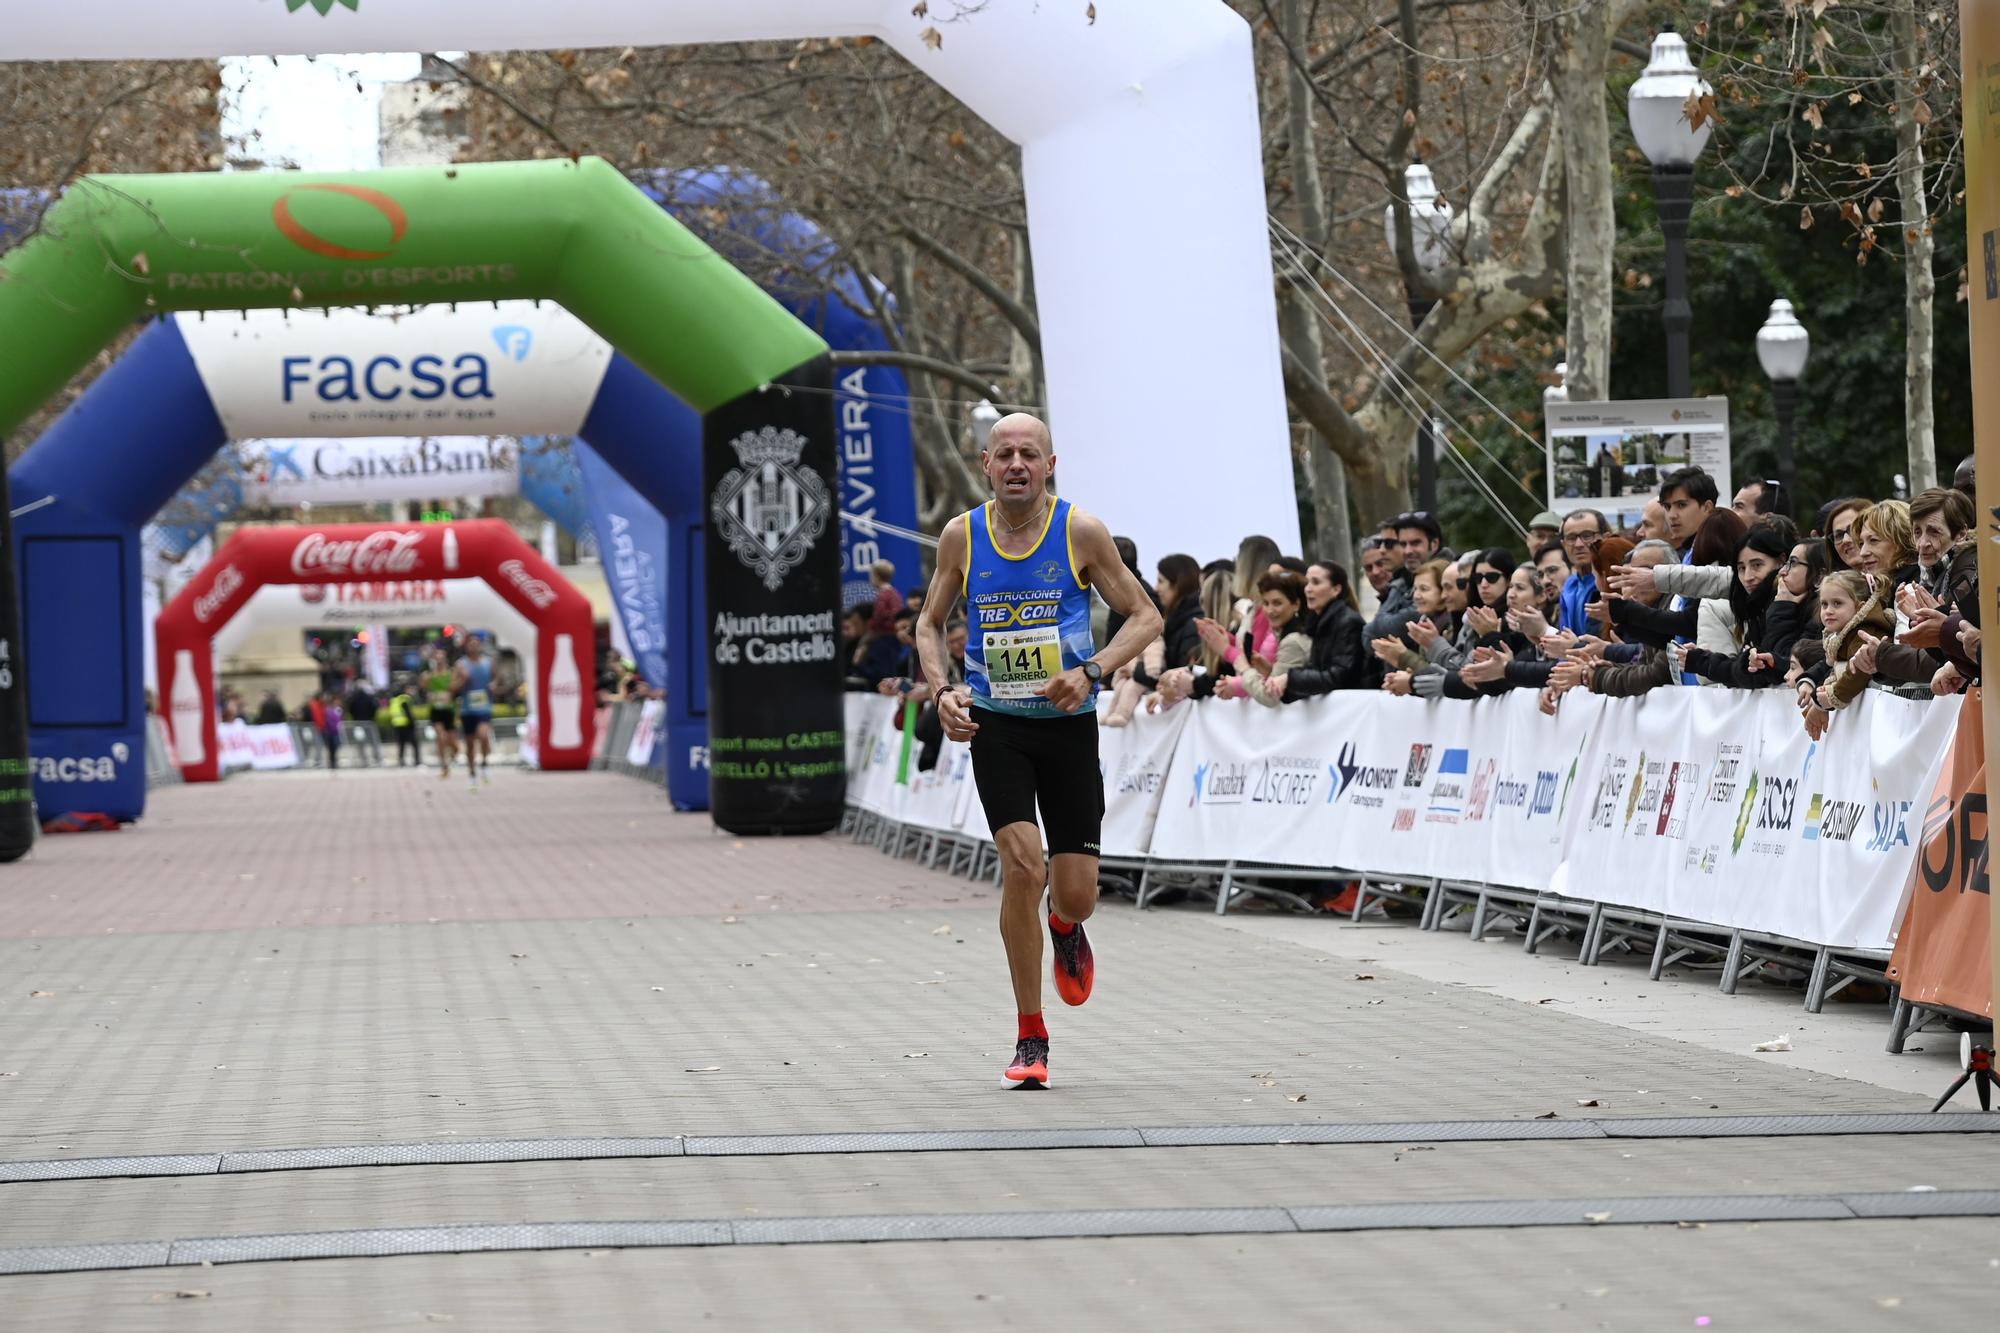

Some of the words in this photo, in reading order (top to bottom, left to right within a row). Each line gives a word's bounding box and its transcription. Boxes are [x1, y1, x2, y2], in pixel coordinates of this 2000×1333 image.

[167, 270, 332, 291] PATRONAT
[343, 263, 518, 288] D'ESPORTS
[841, 366, 880, 574] BAVIERA
[975, 589, 1063, 604] CONSTRUCCIONES
[714, 609, 834, 641] Ajuntament
[715, 637, 741, 664] de
[745, 634, 836, 664] Castelló
[1000, 646, 1043, 673] 141
[1001, 670, 1048, 682] CARRERO
